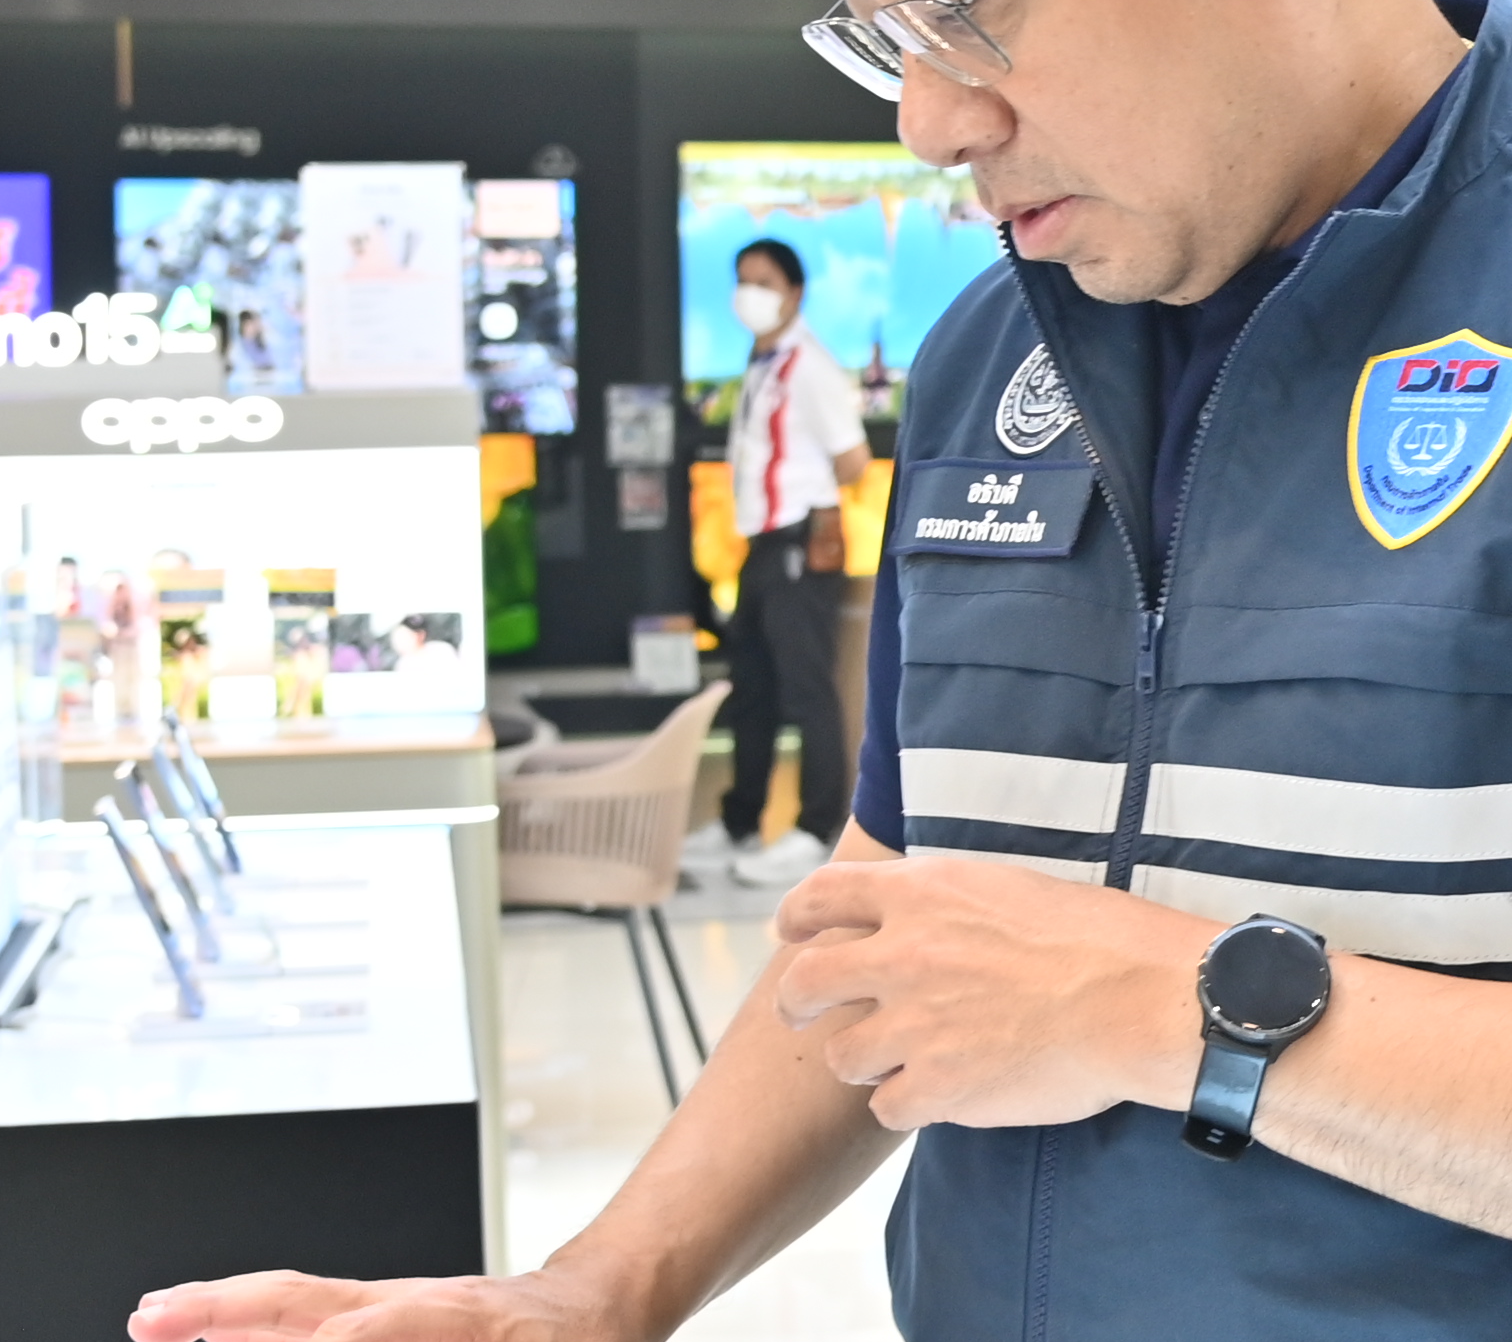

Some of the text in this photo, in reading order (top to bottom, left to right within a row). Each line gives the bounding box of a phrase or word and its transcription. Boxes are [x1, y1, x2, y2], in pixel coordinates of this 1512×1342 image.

[80, 395, 285, 455] oppo
[967, 473, 1024, 505] อธิบดี
[915, 509, 1047, 543] กรมการค้าภายใน
